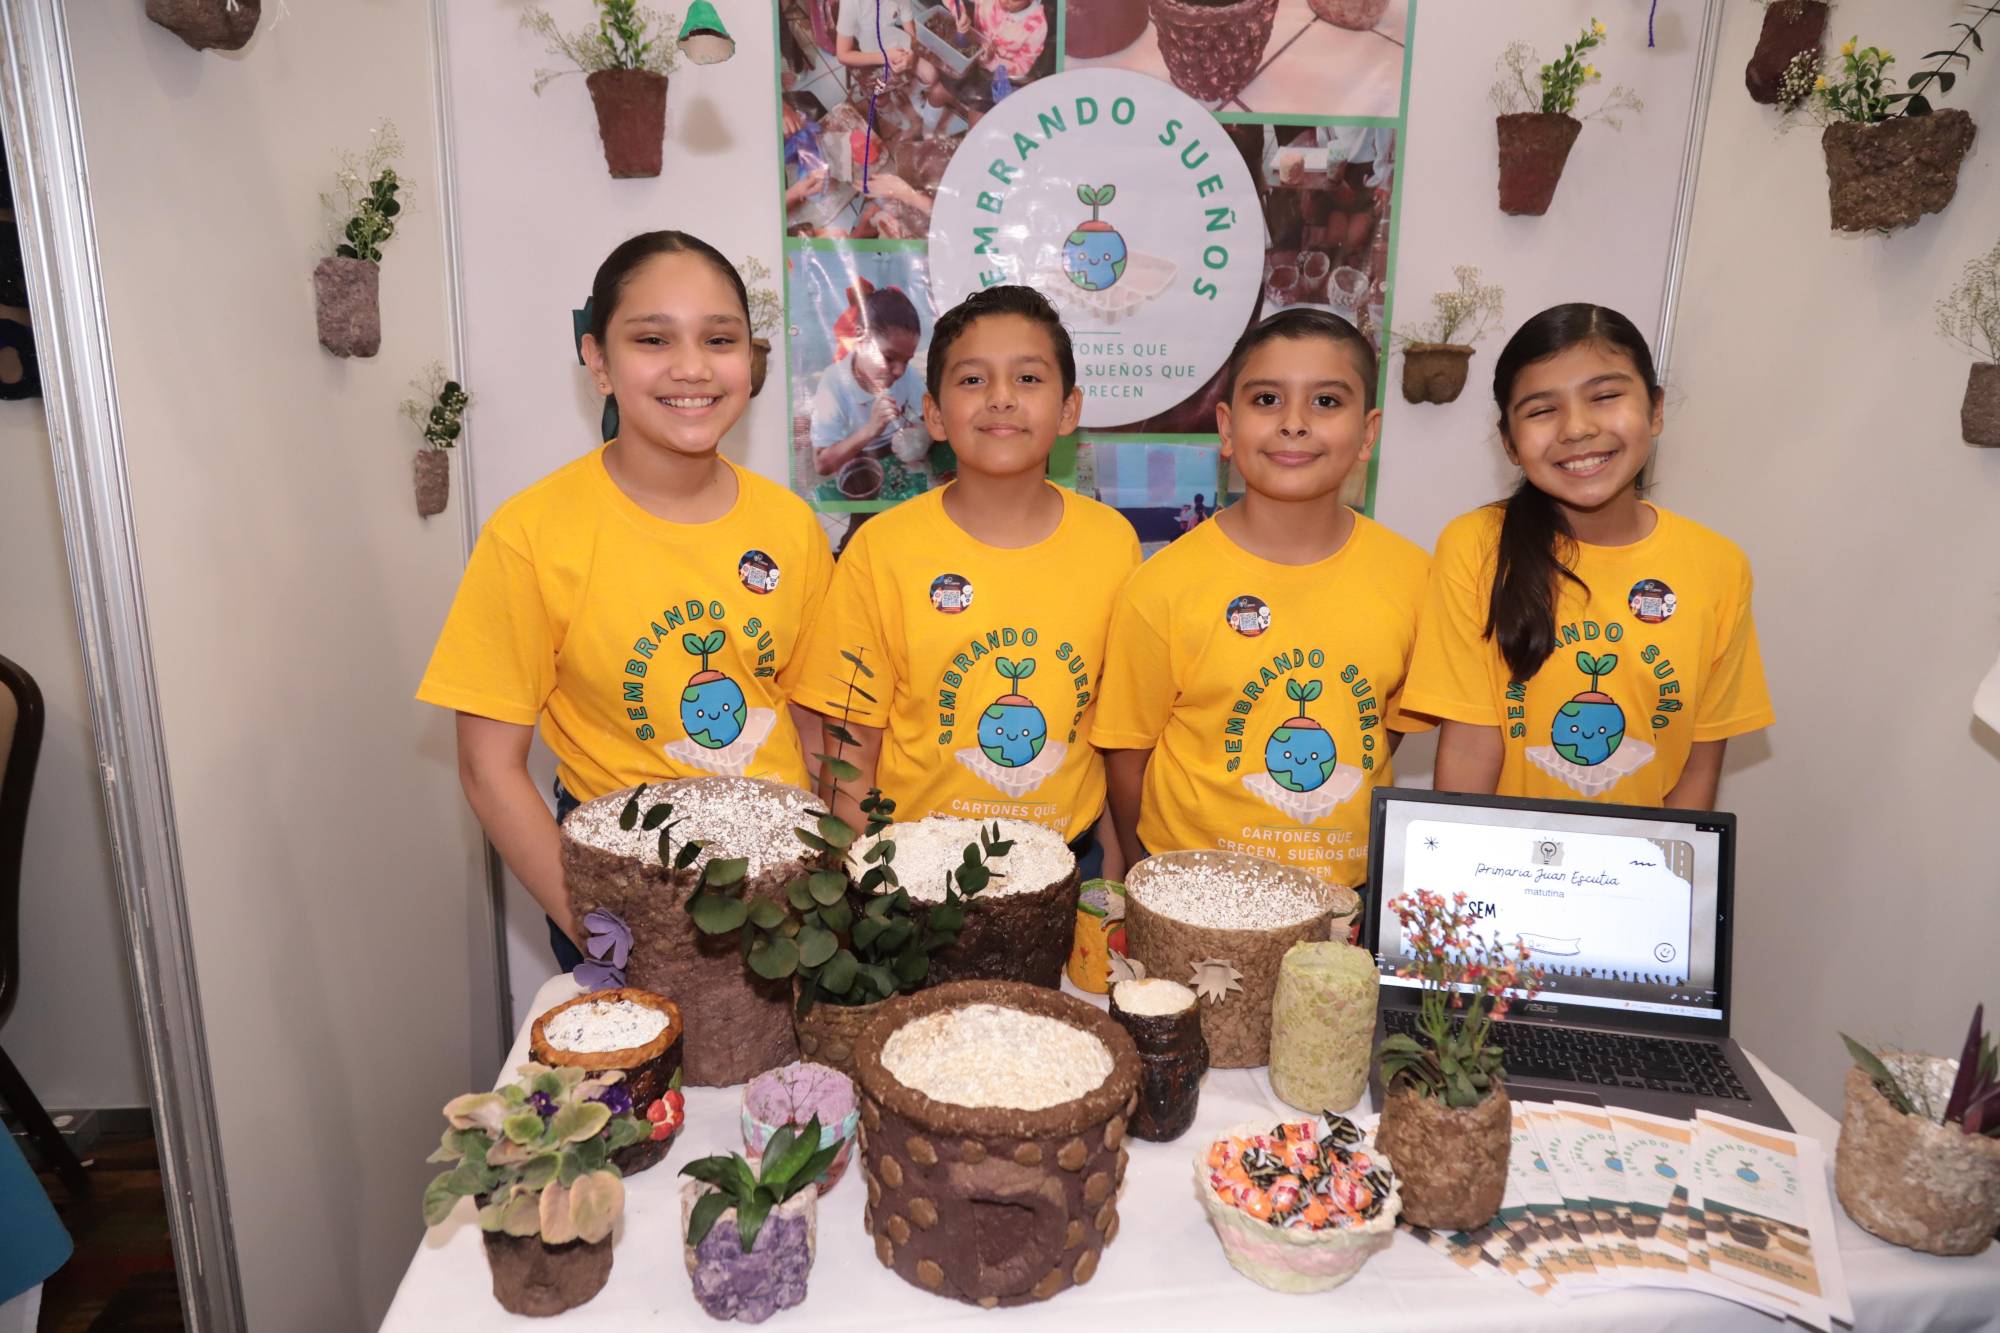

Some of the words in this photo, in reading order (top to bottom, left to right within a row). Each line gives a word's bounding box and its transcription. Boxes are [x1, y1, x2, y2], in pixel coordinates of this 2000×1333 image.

[972, 96, 1136, 288] EMBRANDO
[1158, 118, 1237, 302] SUEÑOS
[1072, 342, 1125, 356] TONES
[1133, 342, 1168, 358] QUE
[1085, 361, 1153, 377] SUEÑOS
[1161, 364, 1196, 379] QUE
[1079, 384, 1144, 398] ORECEN
[623, 599, 725, 741] SEMBRANDO
[743, 617, 776, 678] SUEÑ
[938, 627, 1038, 745] SEMBRANDO
[1640, 644, 1682, 730] SUEÑO
[1225, 647, 1325, 773] SEMBRANDO
[1340, 663, 1380, 771] SUEÑOS
[952, 799, 1029, 817] CARTONES
[1033, 803, 1057, 818] QUE
[1242, 826, 1321, 843] CARTONES
[1327, 831, 1353, 845] QUE
[1288, 846, 1344, 861] SUEÑOS
[1534, 868, 1566, 883] Juan
[1571, 869, 1620, 886] Escutia
[1524, 887, 1565, 899] matutina
[1468, 901, 1497, 919] SEM
[1523, 1003, 1558, 1015] ASUS
